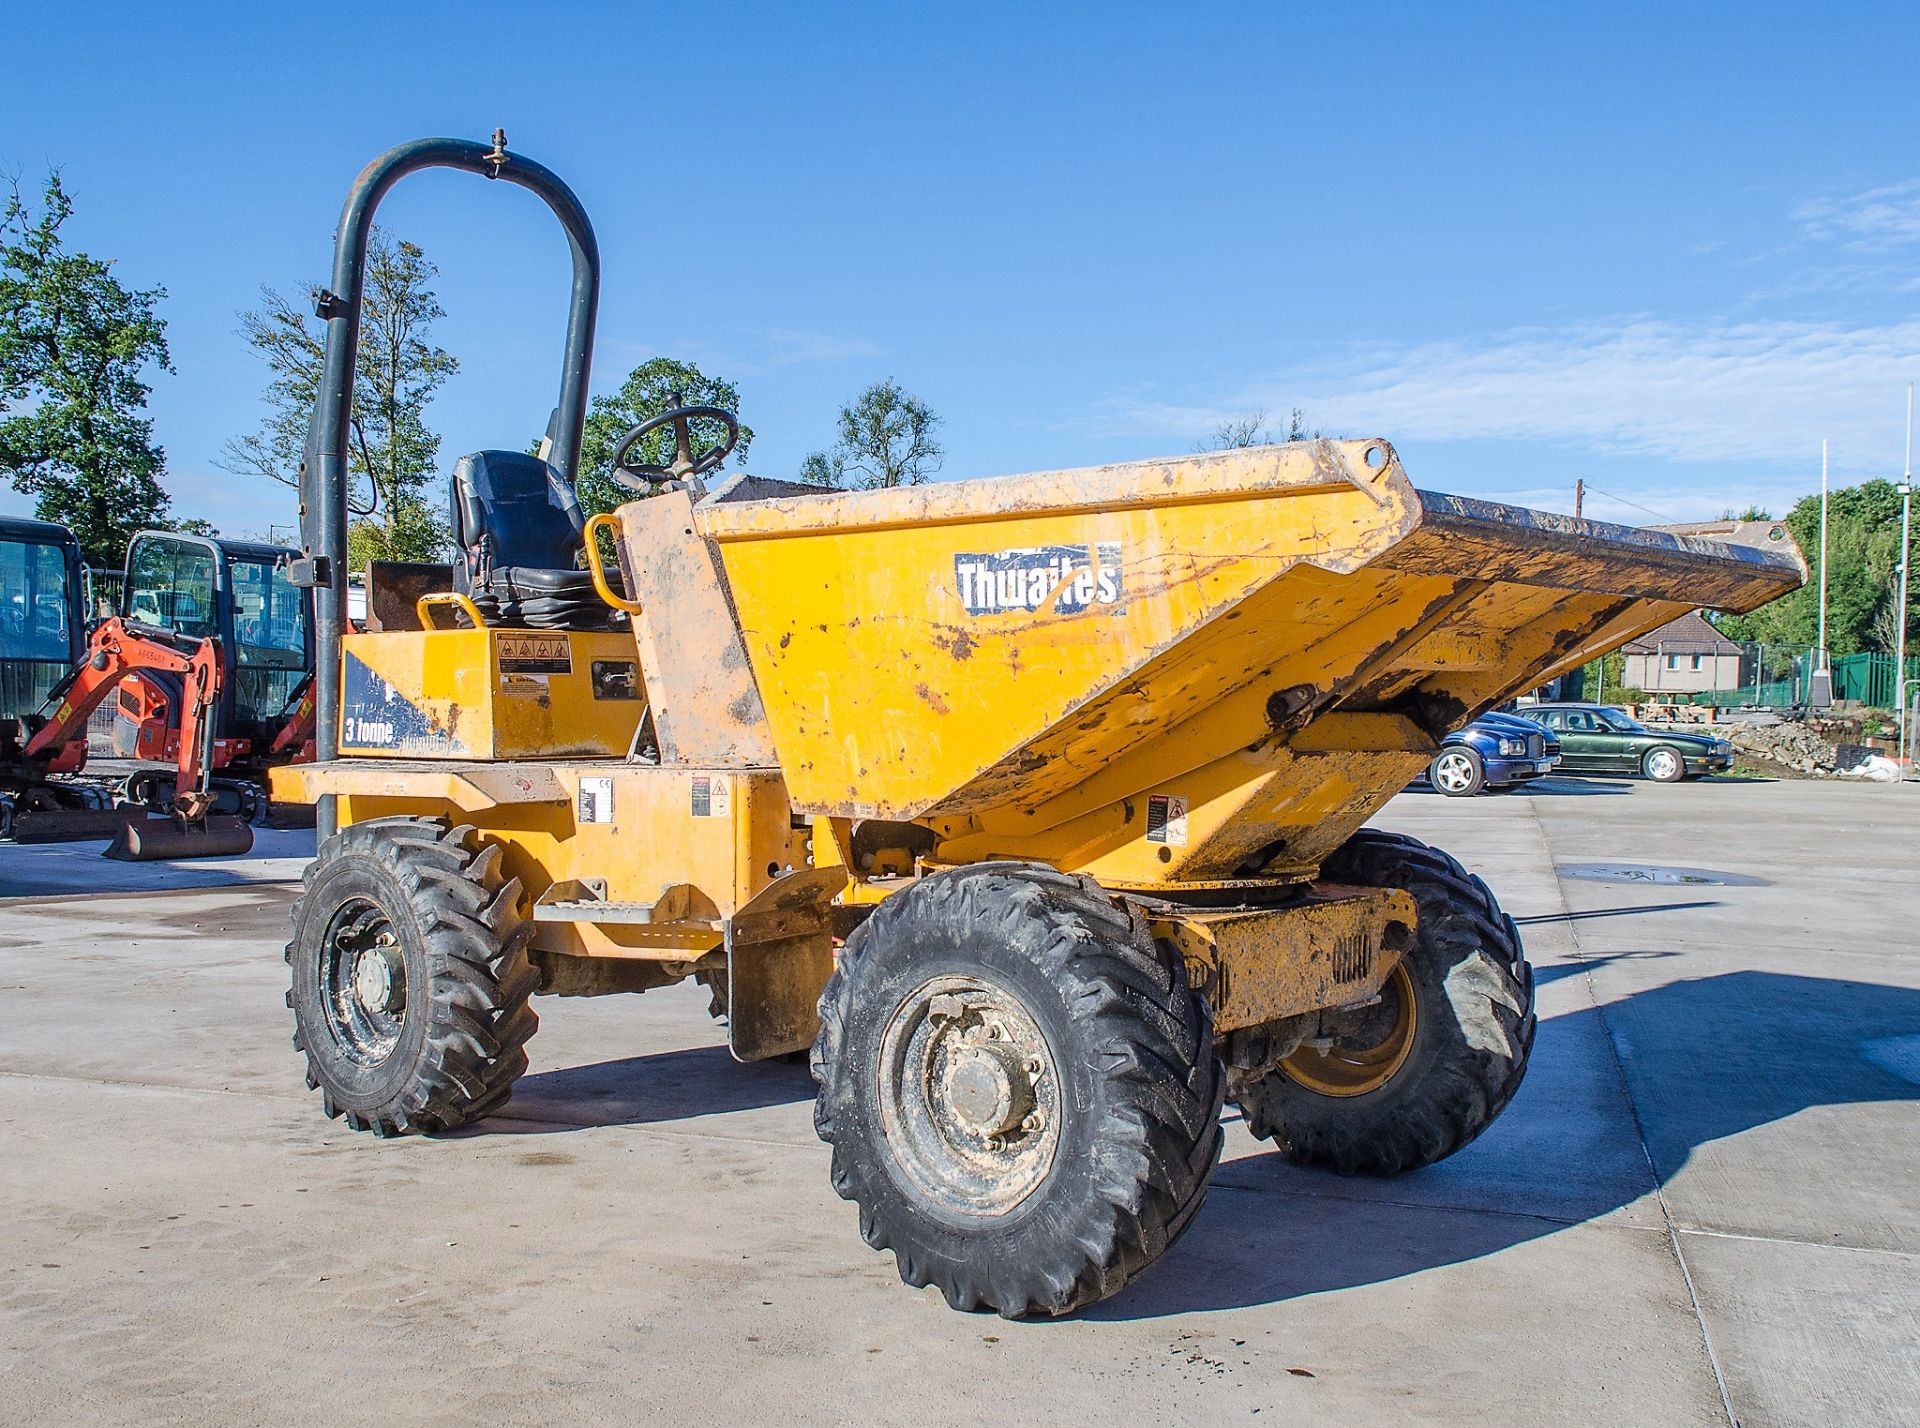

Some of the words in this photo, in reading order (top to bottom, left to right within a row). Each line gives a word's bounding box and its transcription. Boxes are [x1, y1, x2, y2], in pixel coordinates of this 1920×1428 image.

[957, 557, 1116, 608] Thwaites
[345, 717, 355, 743] 3
[357, 717, 394, 744] tonne
